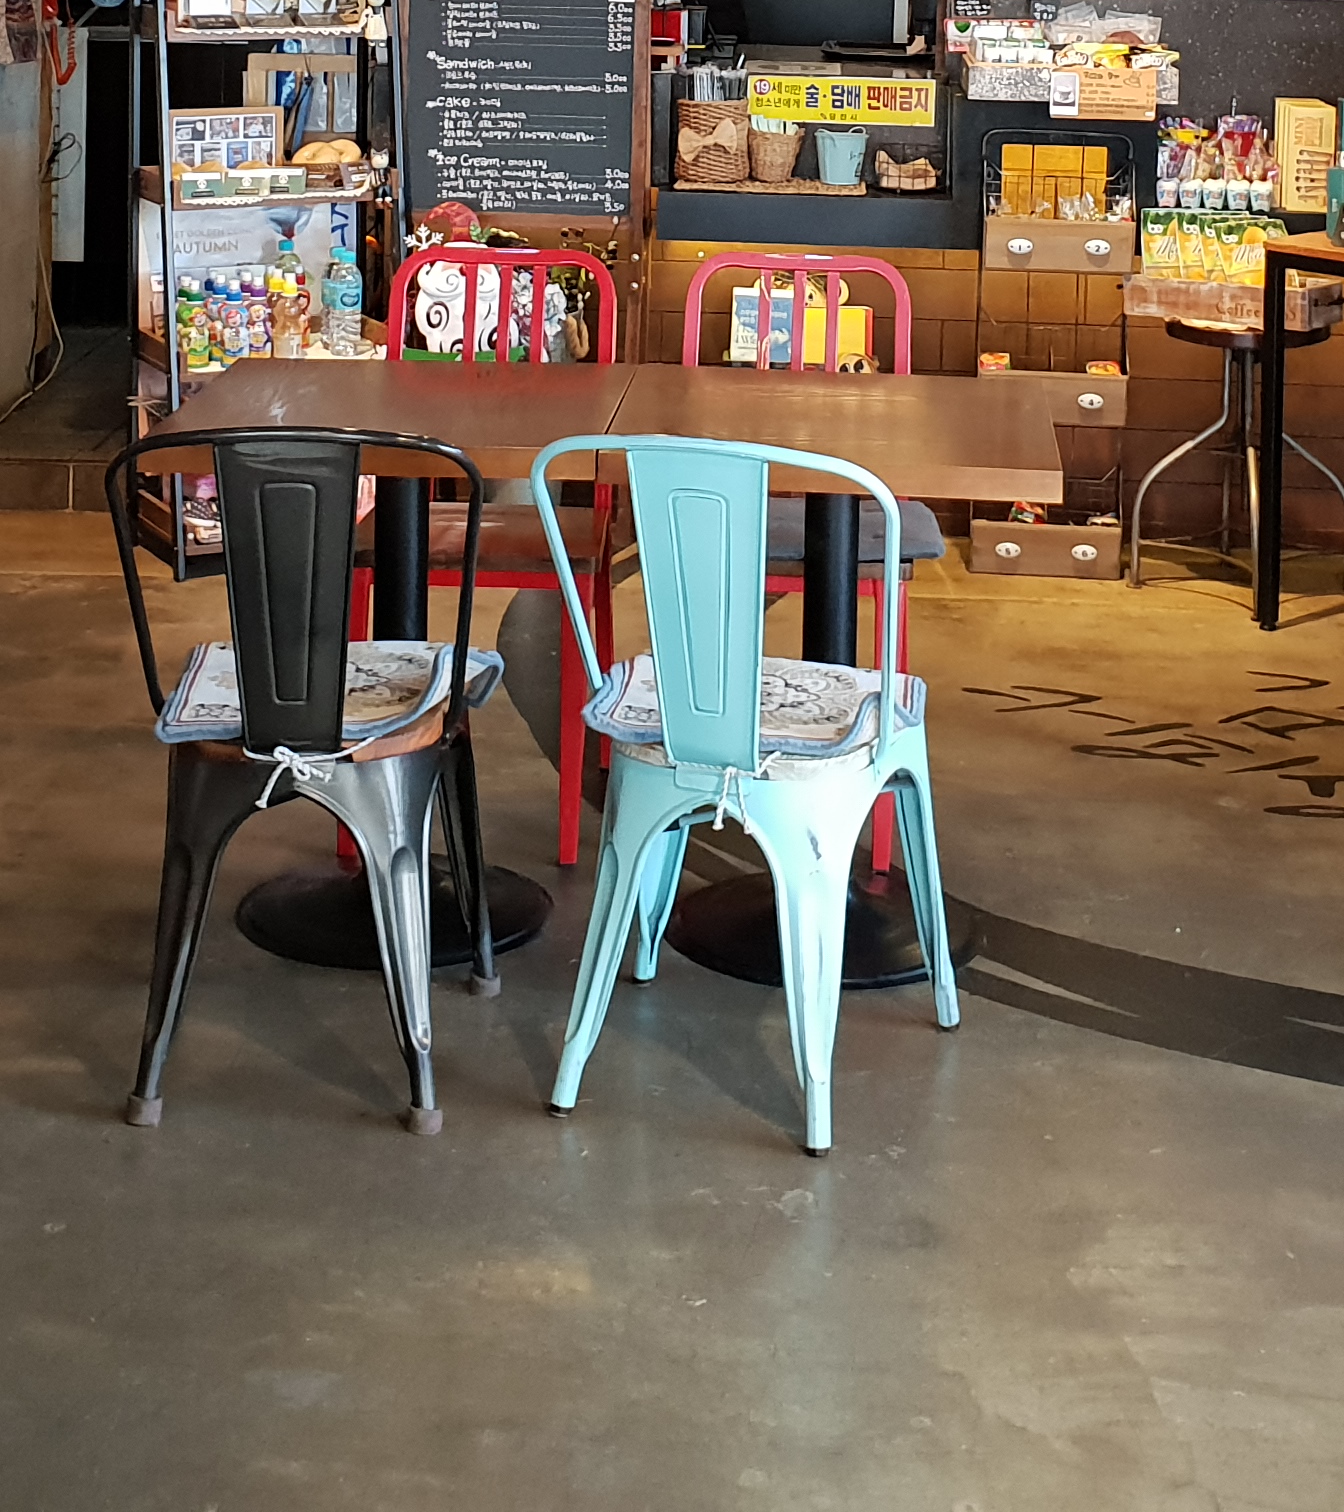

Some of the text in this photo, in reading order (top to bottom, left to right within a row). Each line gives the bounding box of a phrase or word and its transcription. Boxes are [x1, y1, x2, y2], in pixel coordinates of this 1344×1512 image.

[436, 59, 495, 69] Sandwich
[755, 97, 801, 109] 청소년에게
[784, 84, 802, 96] 미만
[866, 85, 930, 113] 판매금지
[174, 240, 239, 255] AUTUMN
[1215, 300, 1261, 320] Coffee
